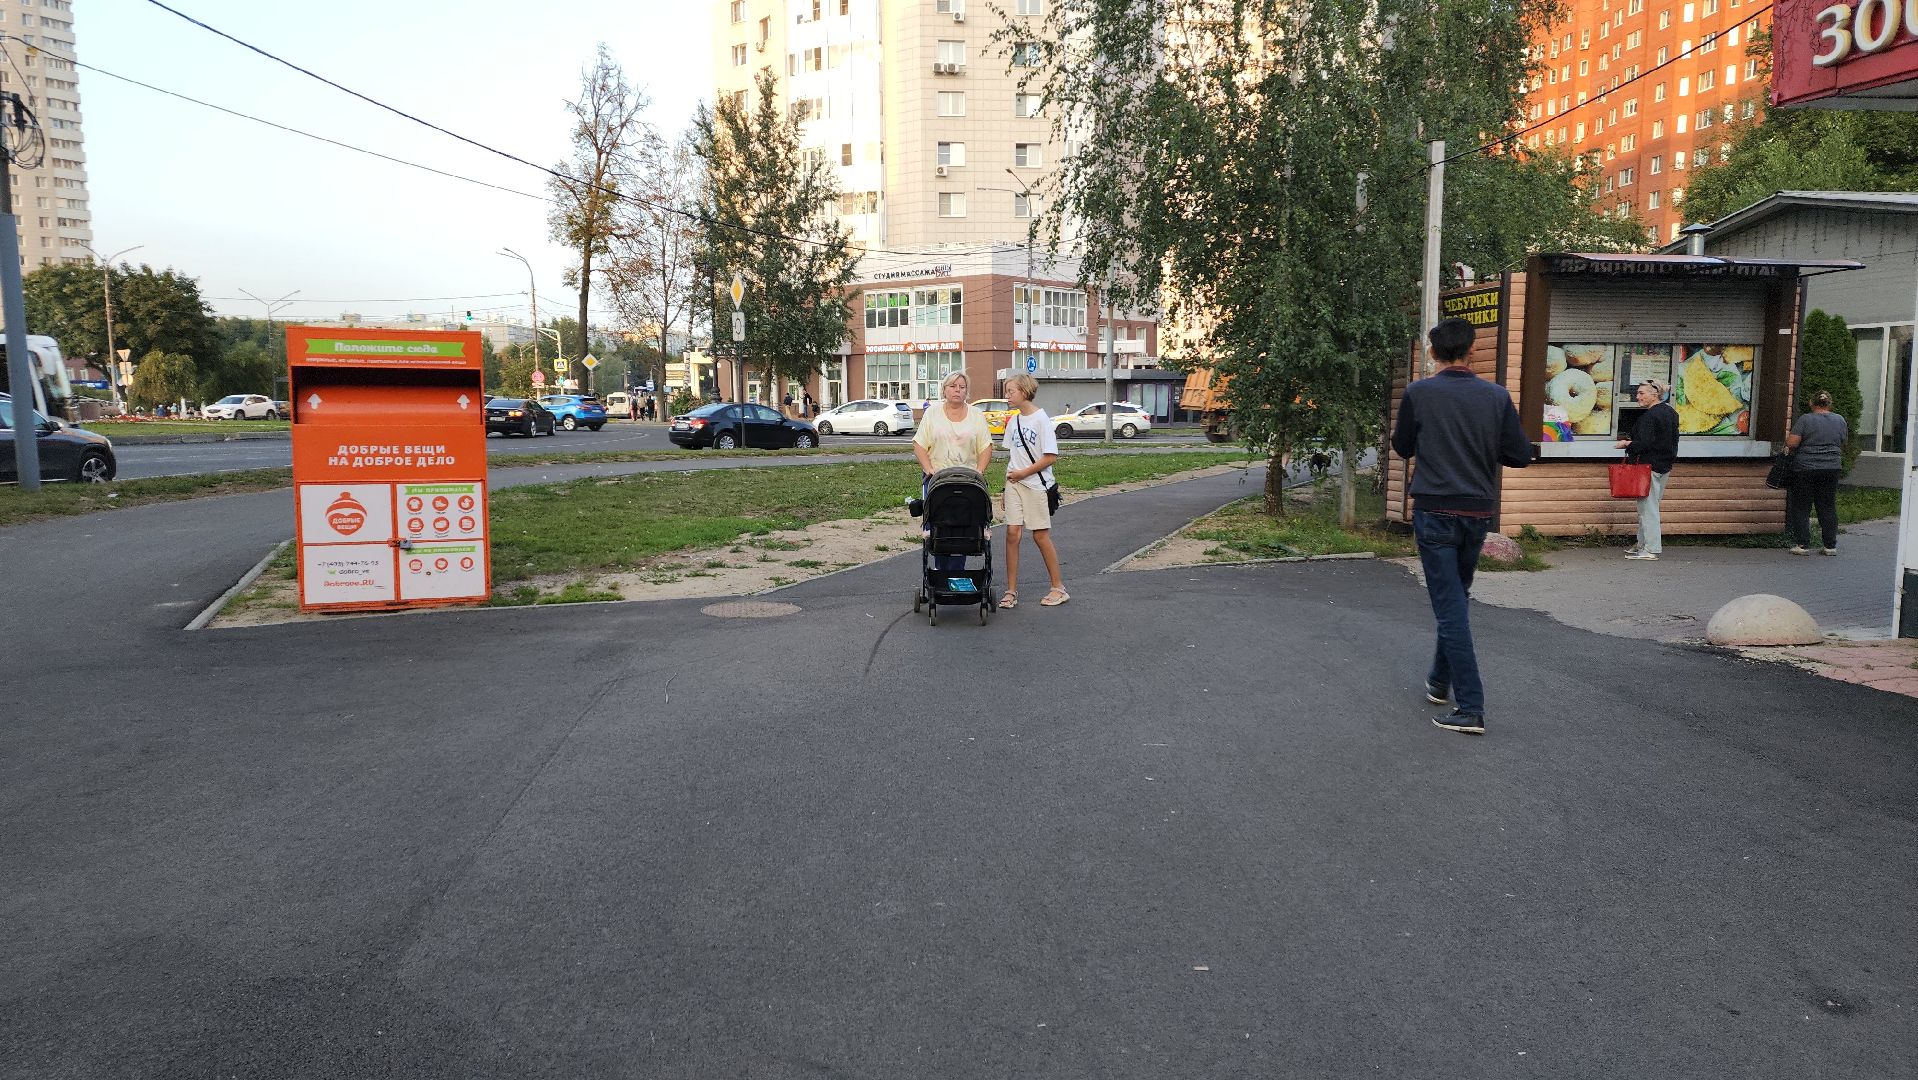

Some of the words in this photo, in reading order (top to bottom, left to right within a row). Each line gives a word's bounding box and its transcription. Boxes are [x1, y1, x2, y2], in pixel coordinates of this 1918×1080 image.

[1443, 292, 1499, 312] ЧЕБУРЕКИ
[1445, 309, 1499, 325] ЧИКИ
[334, 341, 404, 353] Положите
[407, 343, 439, 354] сюда
[337, 445, 400, 455] ДОБРЫЕ
[404, 445, 446, 455] ВЕЩИ
[328, 456, 349, 466] НА
[352, 456, 413, 467] ДОБРОЕ
[416, 456, 456, 467] ДЕЛО
[332, 517, 361, 525] ДОБРЫЕ
